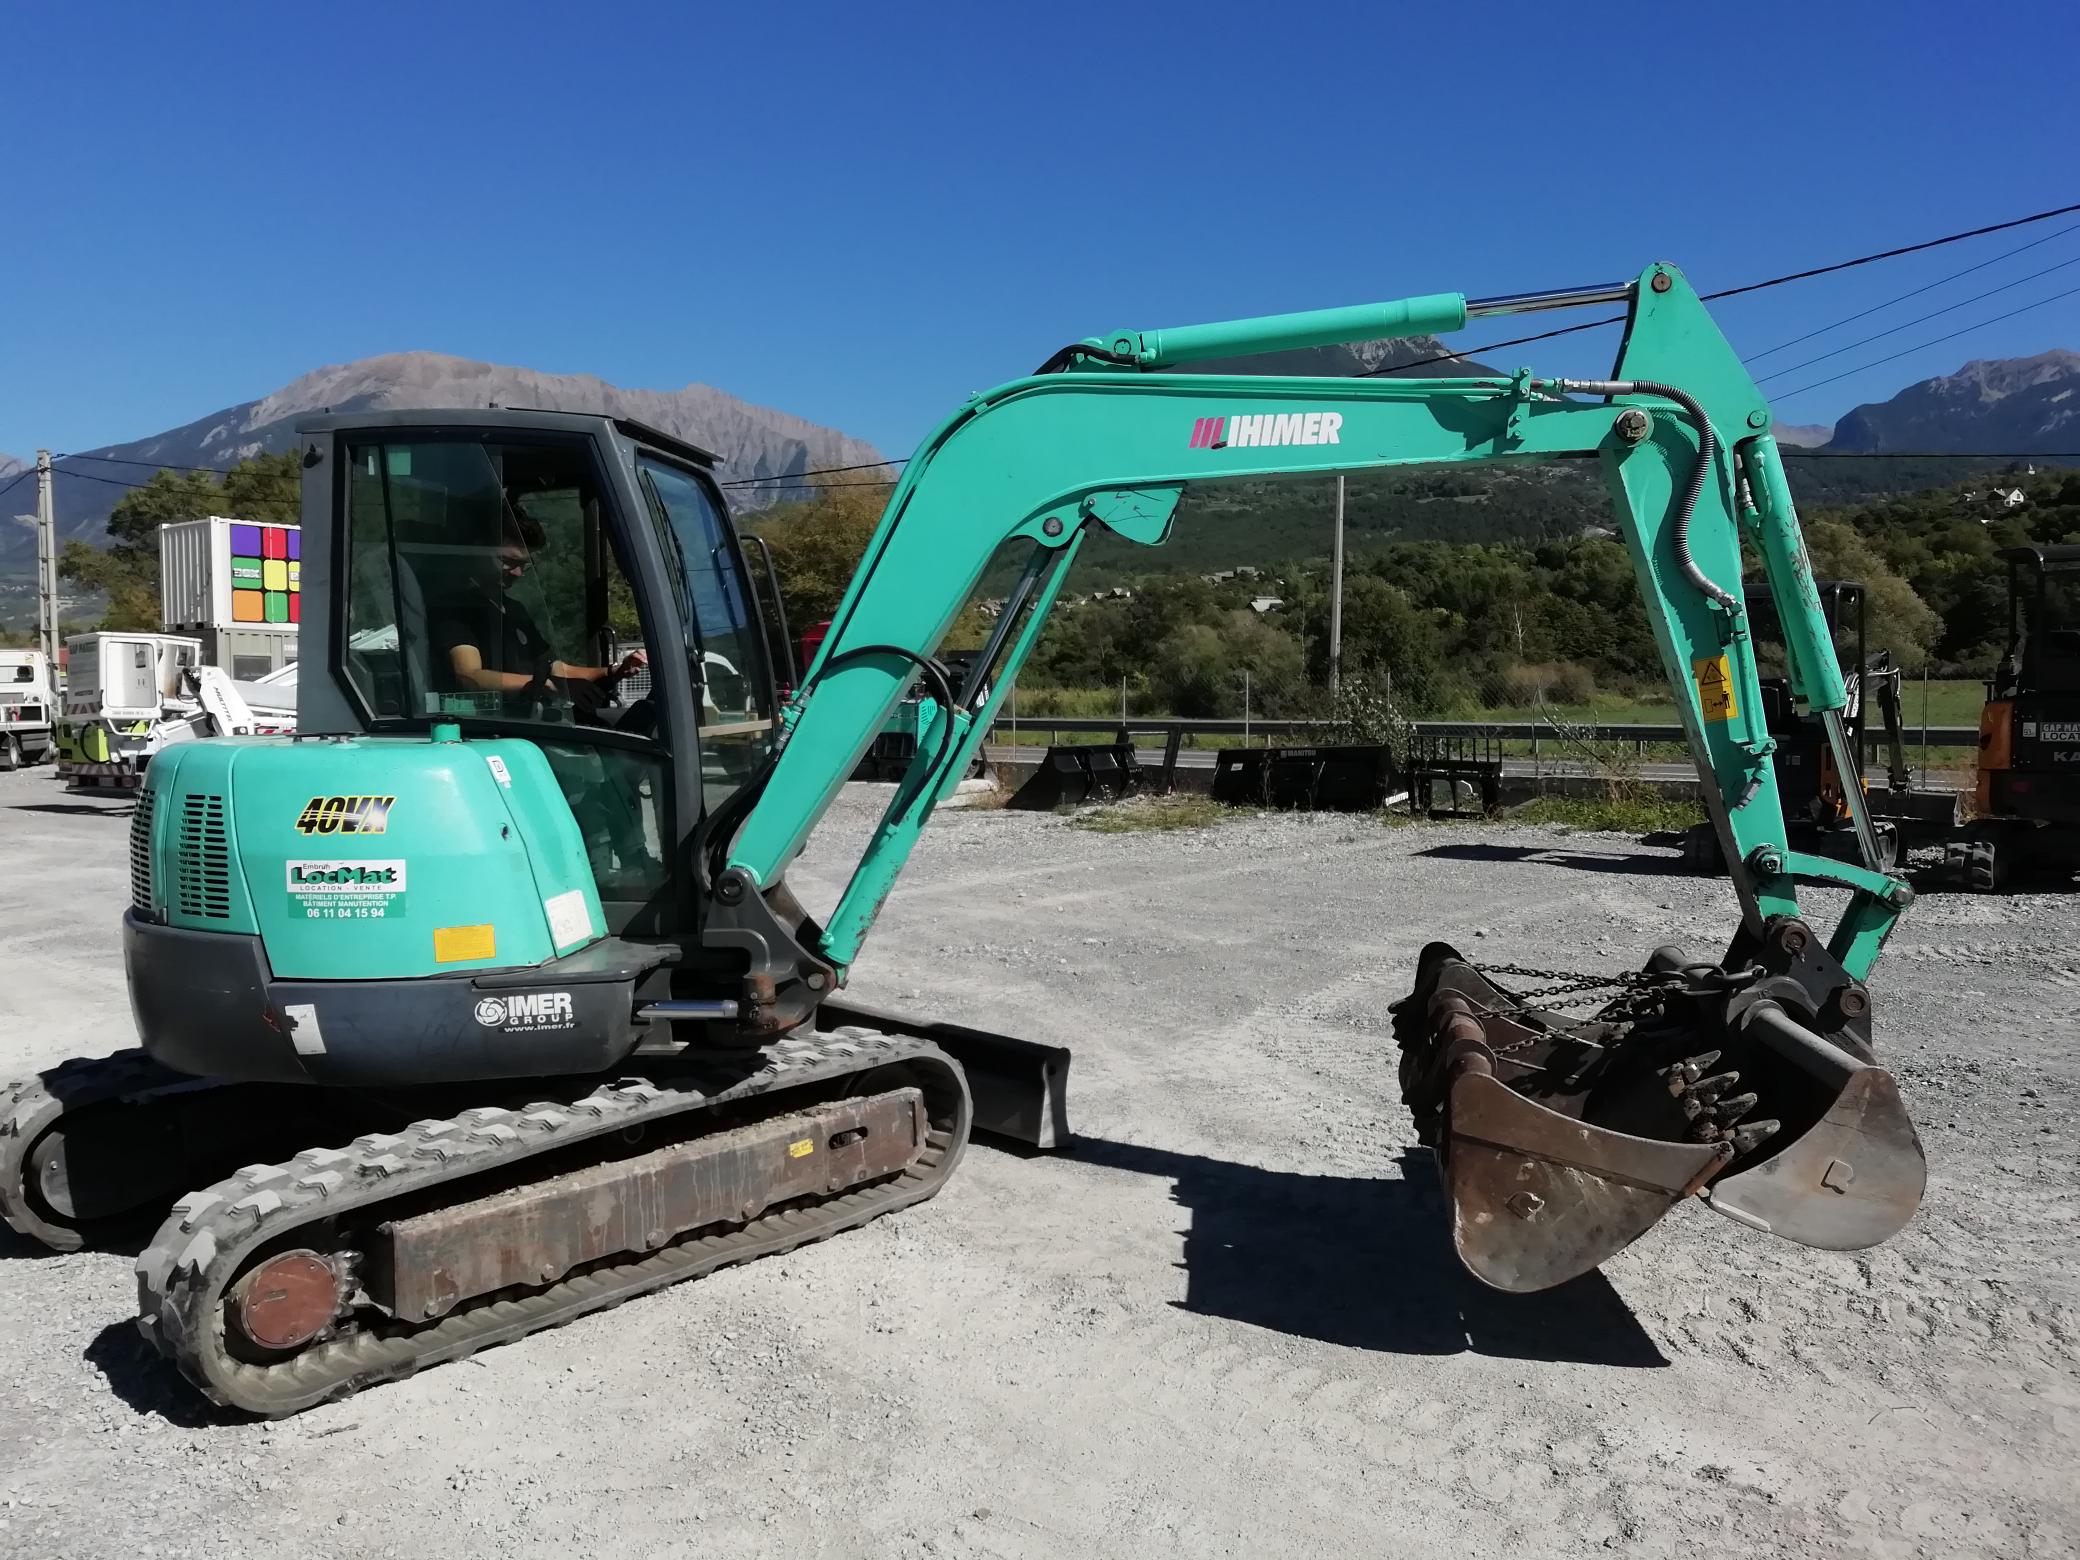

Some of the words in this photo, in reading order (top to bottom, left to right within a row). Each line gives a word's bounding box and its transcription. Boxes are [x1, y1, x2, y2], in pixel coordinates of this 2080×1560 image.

[1227, 412, 1343, 447] IHIMER
[2043, 723, 2061, 731] GAP
[294, 796, 396, 835] 40VX
[291, 867, 397, 884] LocMat
[307, 908, 320, 918] 06
[323, 908, 334, 918] 11
[338, 908, 351, 918] 04
[355, 908, 368, 918] 15
[370, 908, 385, 918] 94
[508, 992, 573, 1017] IMER
[509, 1013, 573, 1025] GROUP
[504, 1022, 575, 1033] www.imer.fr
